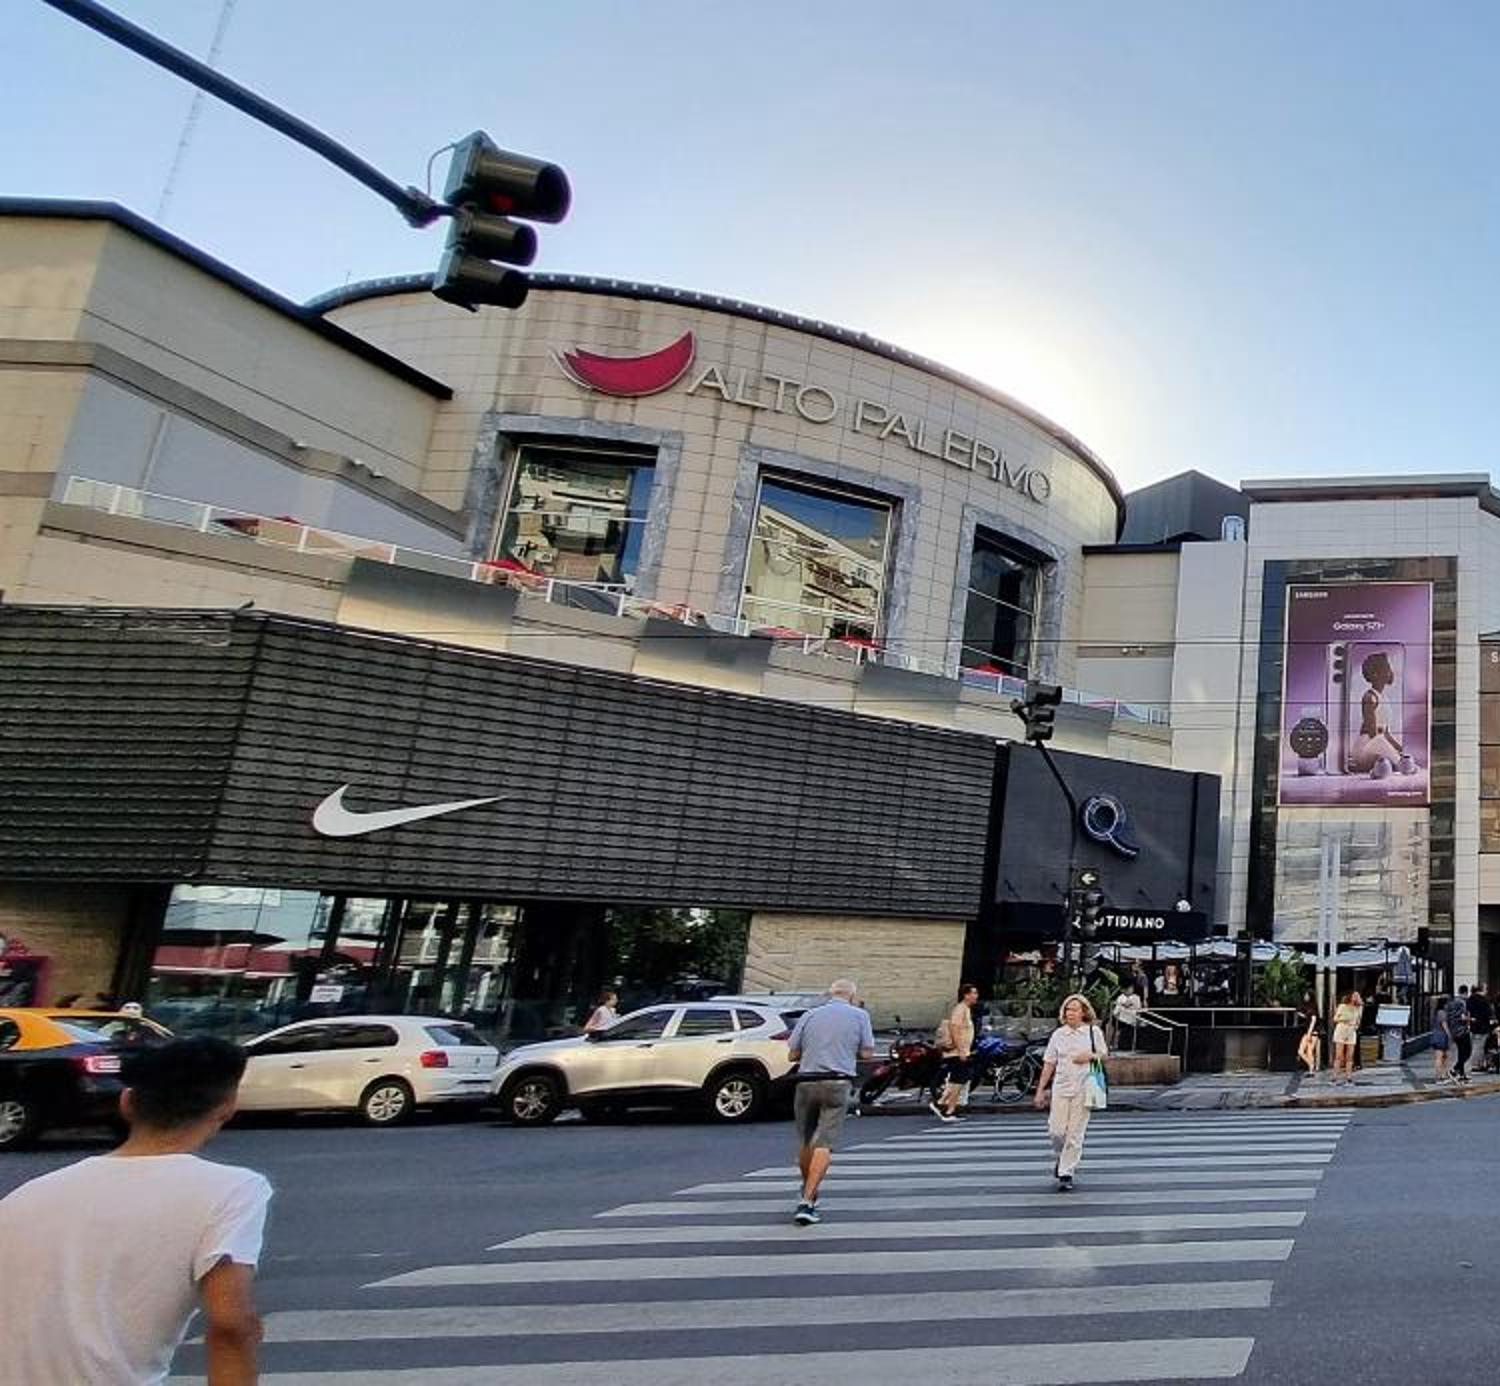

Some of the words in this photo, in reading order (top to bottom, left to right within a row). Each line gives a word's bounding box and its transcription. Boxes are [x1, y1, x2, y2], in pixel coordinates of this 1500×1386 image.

[686, 364, 839, 425] ALTO
[852, 398, 1052, 505] PALERMO
[1072, 915, 1165, 929] TIDIANO
